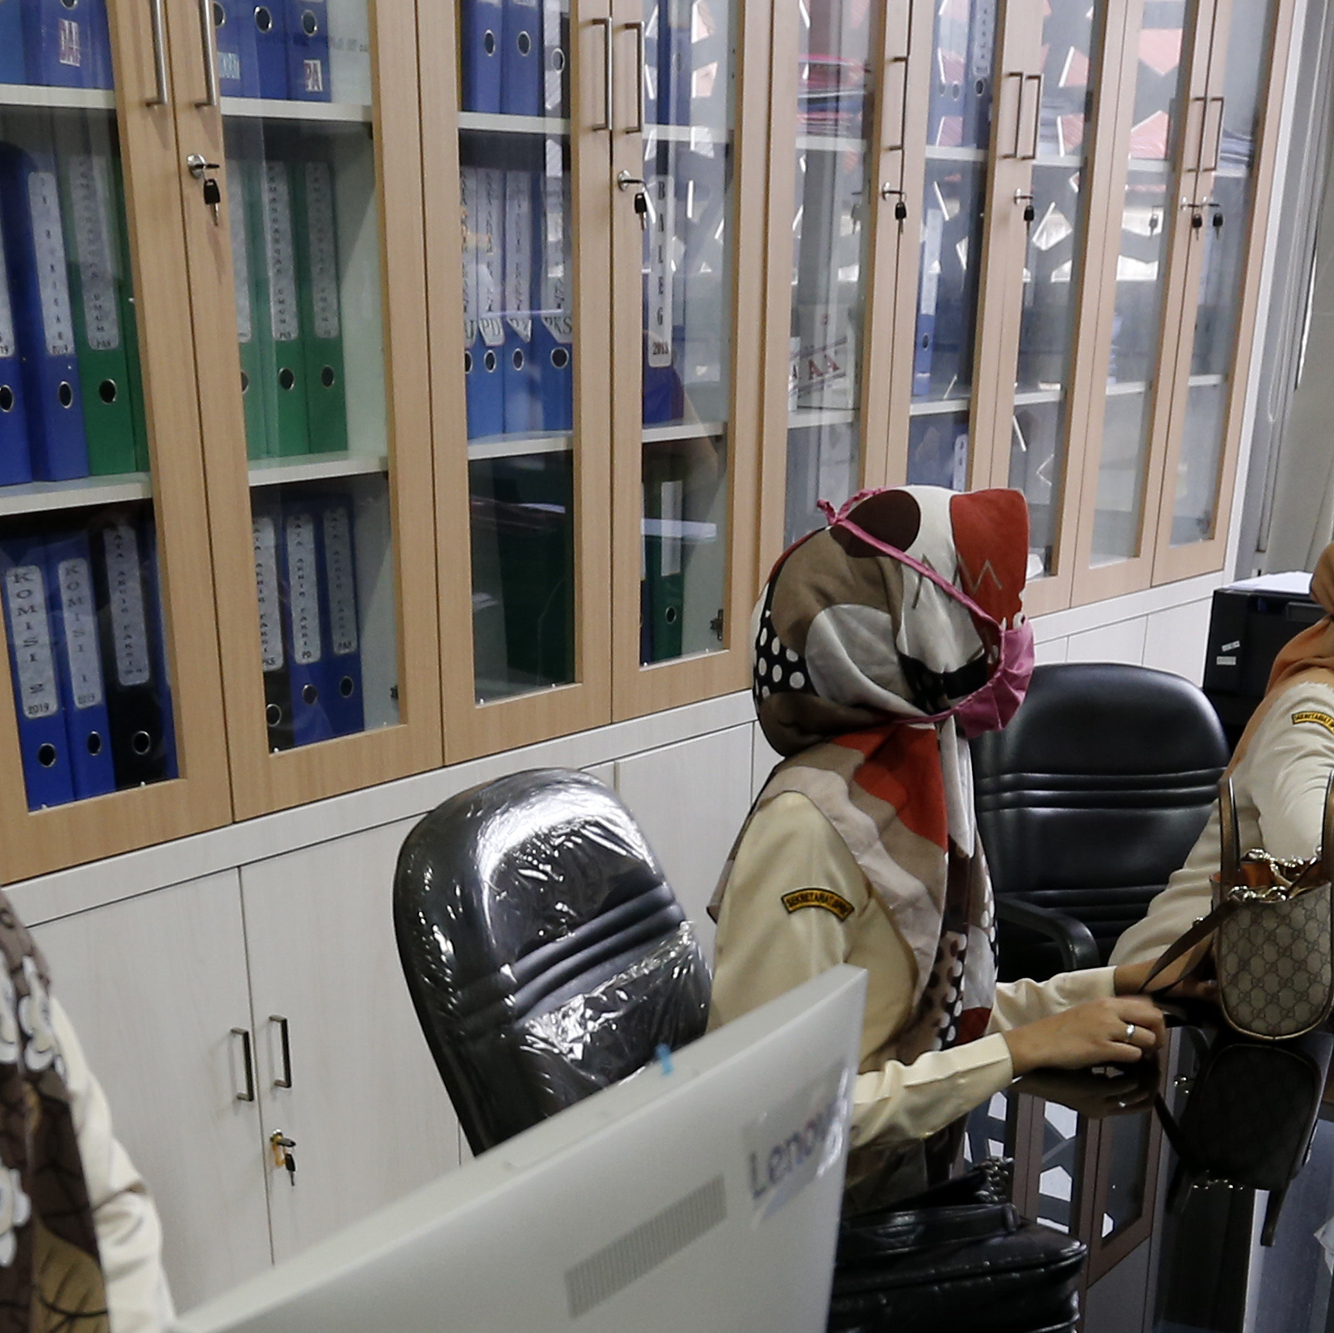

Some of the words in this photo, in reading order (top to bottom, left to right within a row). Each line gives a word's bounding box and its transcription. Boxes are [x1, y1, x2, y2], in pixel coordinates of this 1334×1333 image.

[14, 571, 39, 663] KOMISI
[27, 702, 50, 715] 2019
[750, 1103, 841, 1200] Lenov
